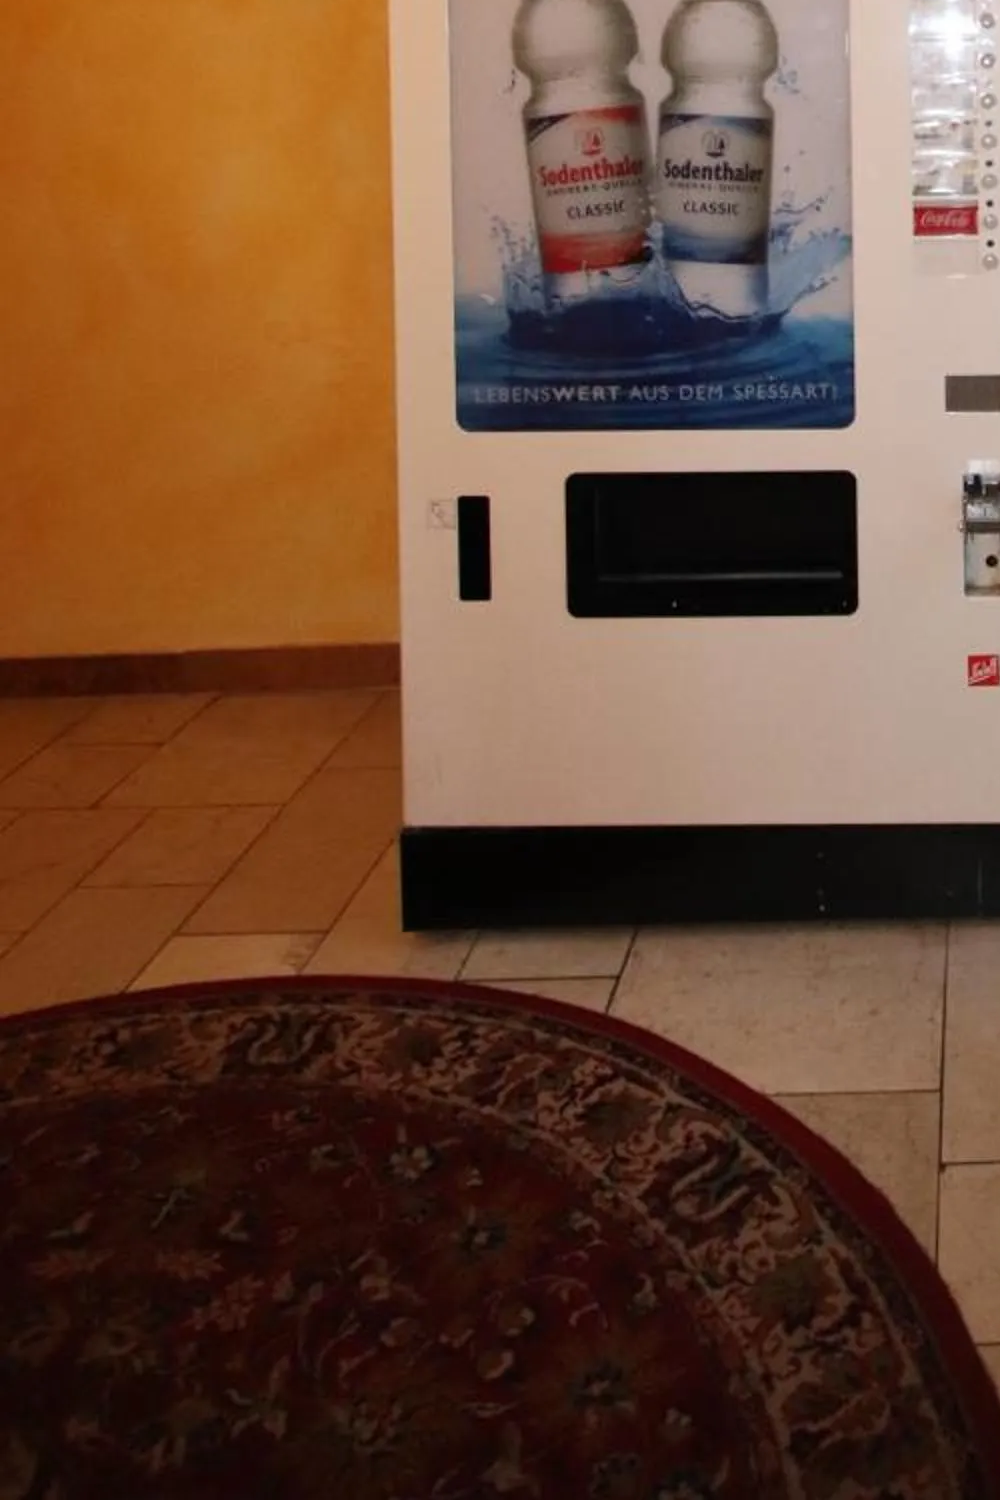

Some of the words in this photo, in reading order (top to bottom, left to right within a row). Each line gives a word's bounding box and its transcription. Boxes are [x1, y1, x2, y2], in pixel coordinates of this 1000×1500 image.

[538, 155, 643, 187] Sodenthaler
[663, 158, 764, 183] Sodenthaler
[566, 200, 625, 219] CLASSIC
[683, 201, 740, 216] CLASSIC
[475, 385, 619, 404] LEBENSWERT
[629, 384, 670, 401] AUS
[680, 384, 723, 401] DEM
